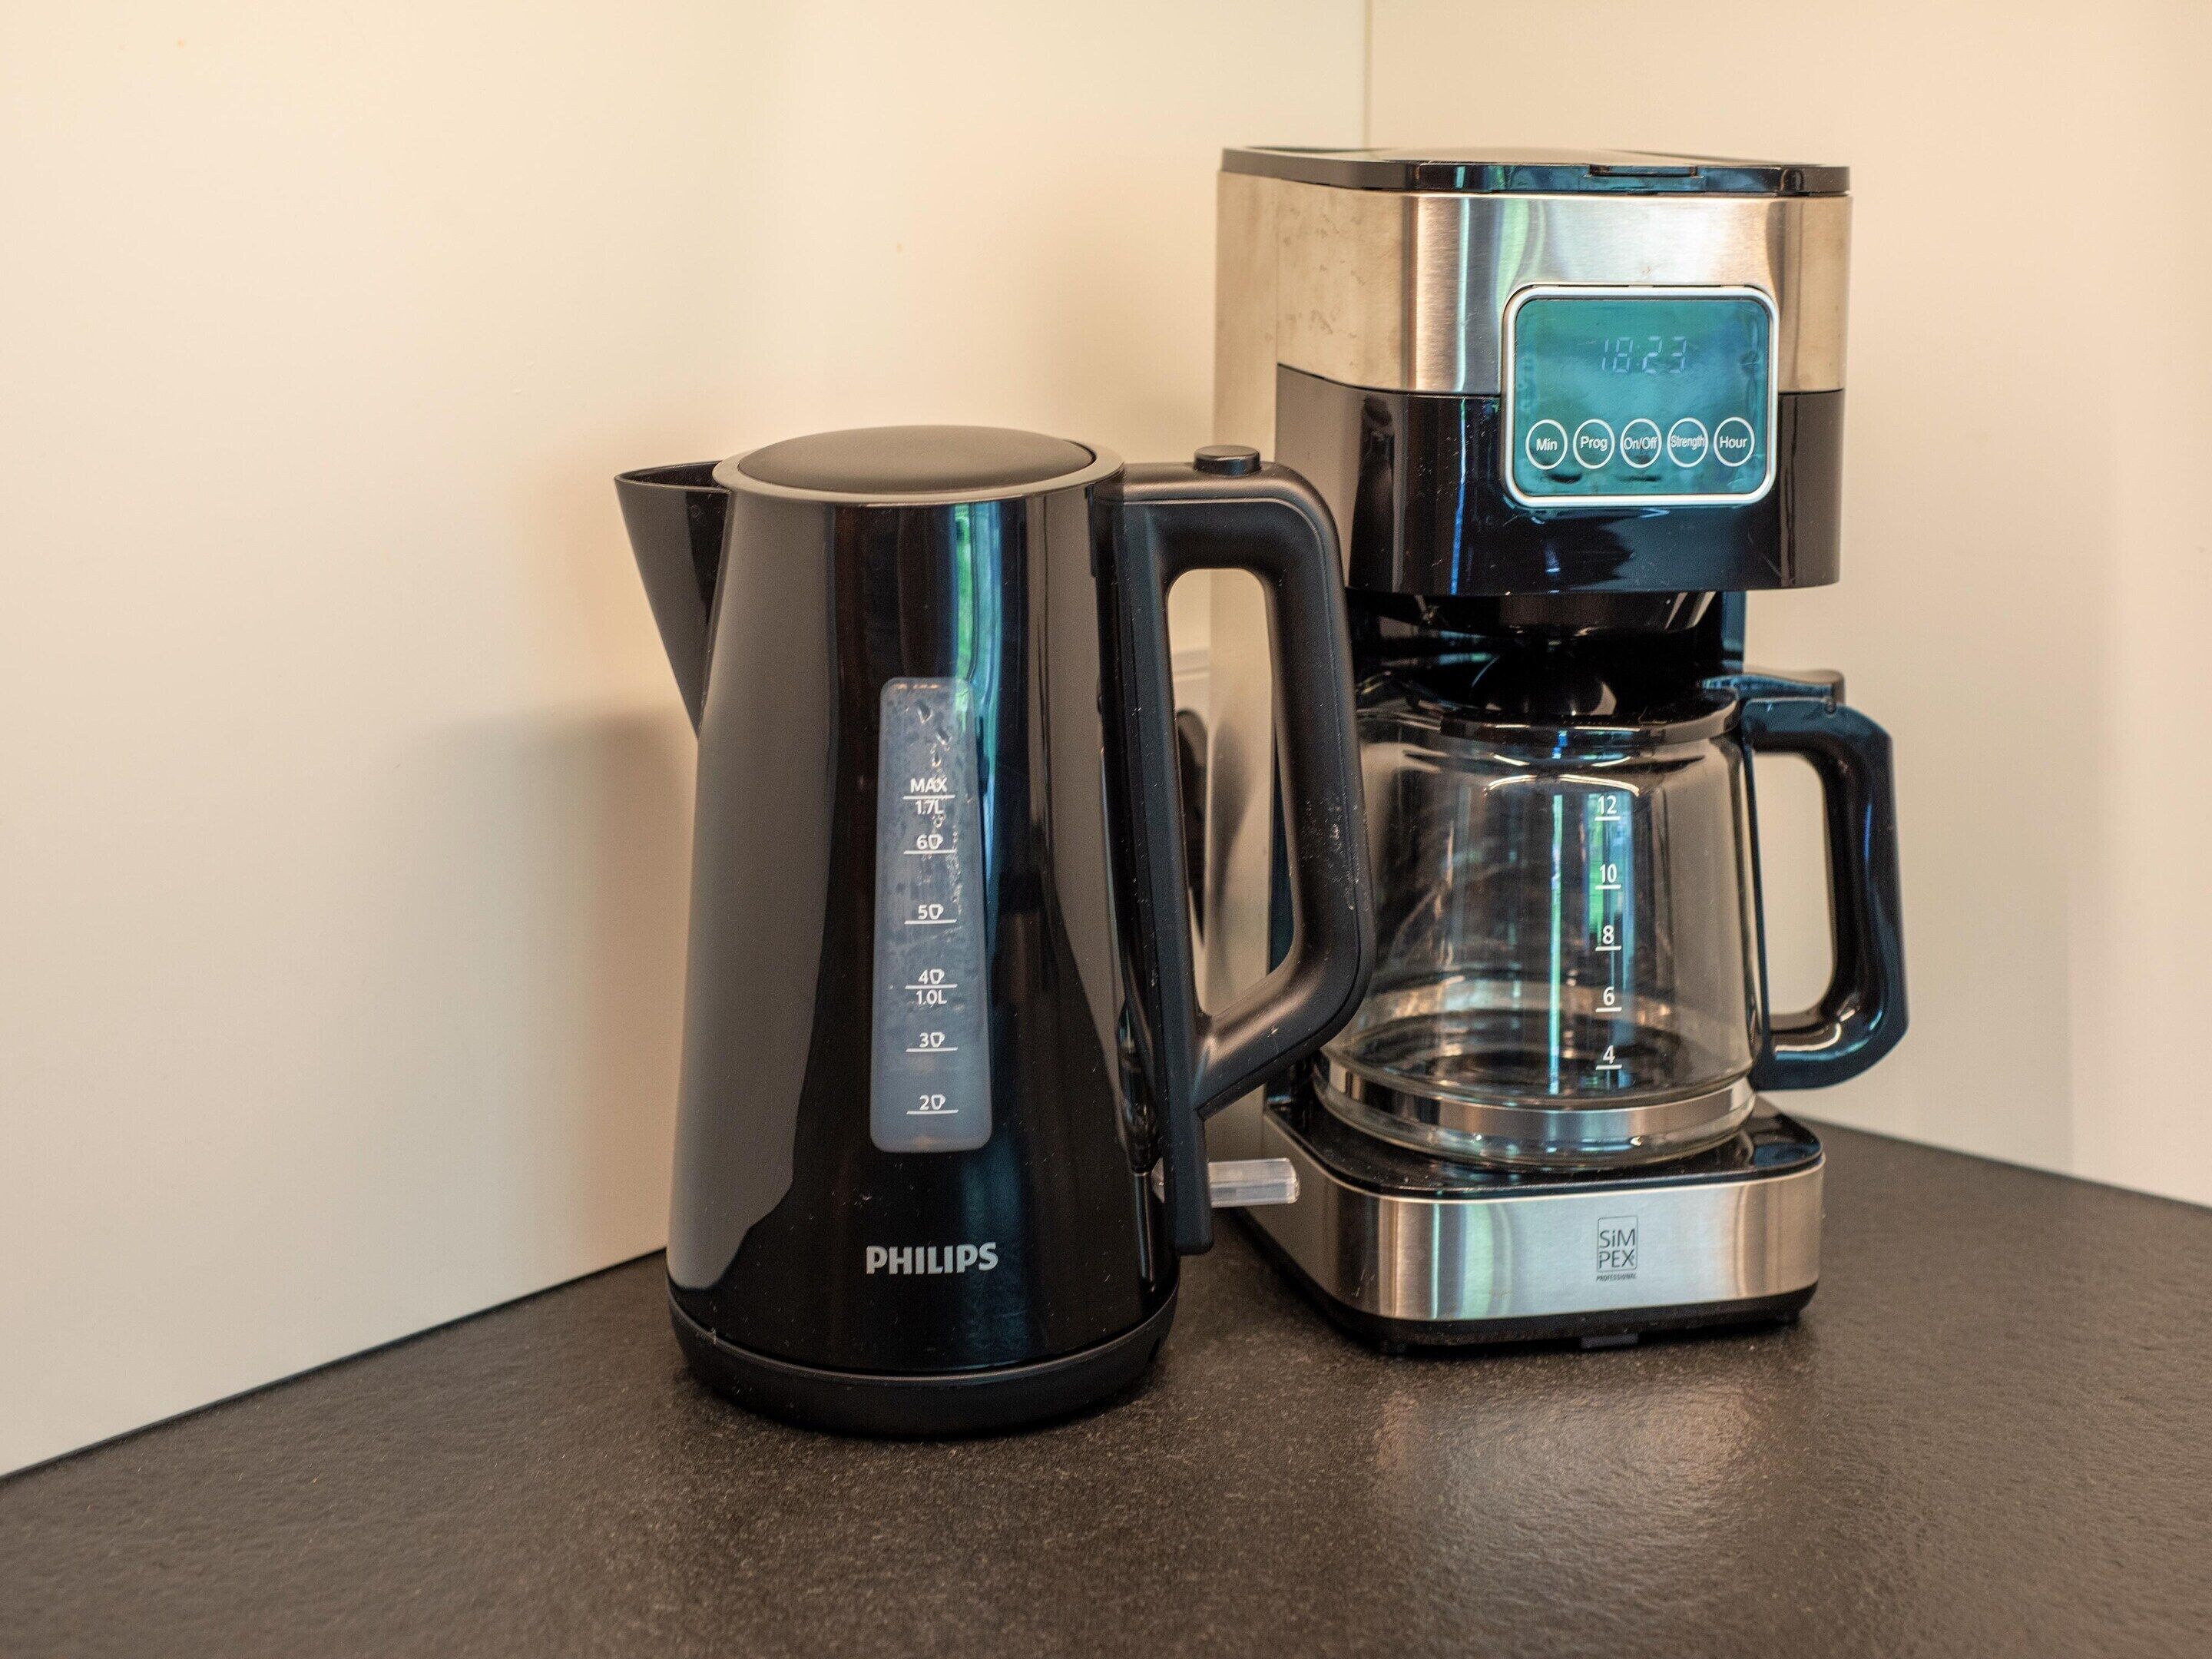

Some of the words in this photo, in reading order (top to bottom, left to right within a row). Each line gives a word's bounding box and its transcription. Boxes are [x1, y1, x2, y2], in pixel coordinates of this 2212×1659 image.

[1536, 438, 1558, 451] Min
[1580, 435, 1608, 452] Prog
[1624, 436, 1658, 450] On/Off
[1670, 435, 1705, 451] Strength
[1719, 435, 1748, 449] Hour
[909, 777, 948, 793] MAX
[915, 800, 945, 815] 1.7L
[1597, 794, 1618, 815] 12
[1599, 863, 1618, 884] 10
[1602, 924, 1615, 945] 8
[916, 989, 948, 1005] 1.0L
[1602, 985, 1615, 1006] 6
[1602, 1045, 1616, 1065] 4
[866, 1241, 998, 1275] PHILIPS
[1598, 1249, 1635, 1269] PEX
